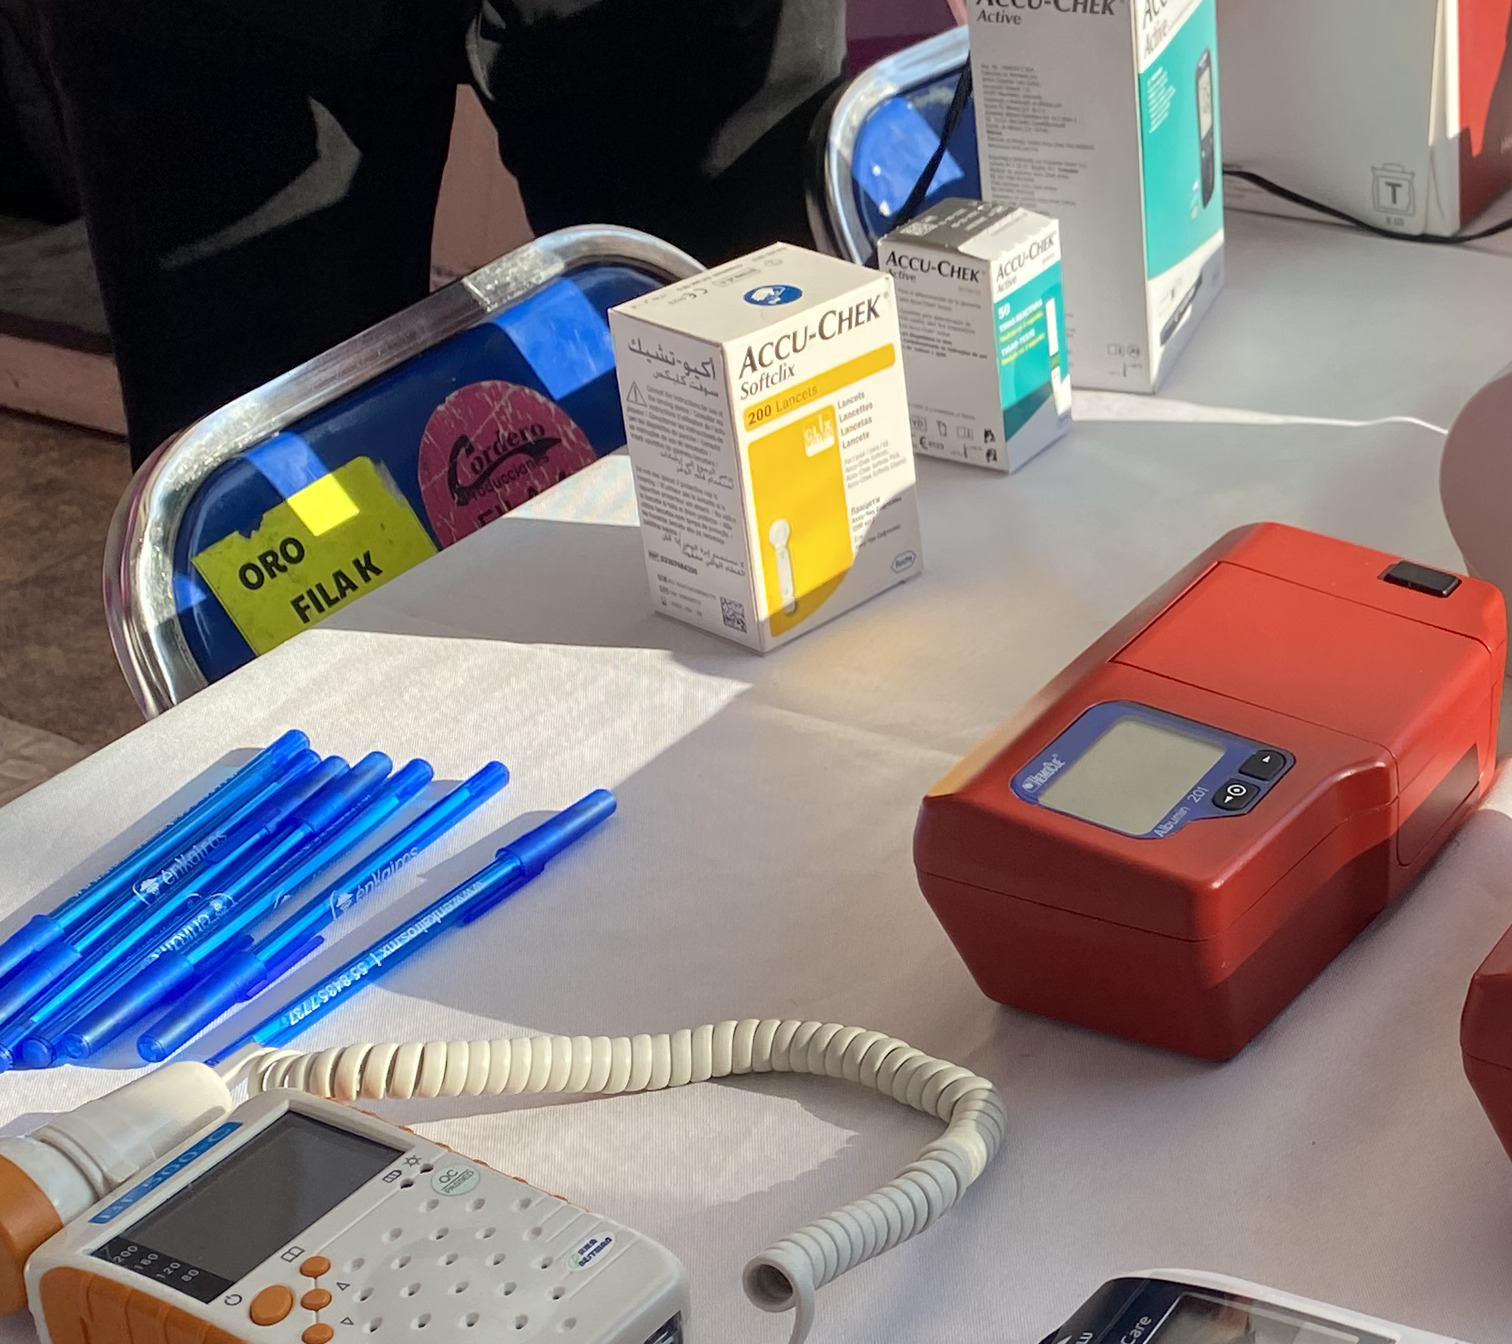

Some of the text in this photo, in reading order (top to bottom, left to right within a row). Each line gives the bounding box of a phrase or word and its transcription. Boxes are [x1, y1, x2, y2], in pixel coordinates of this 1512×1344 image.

[977, 8, 1022, 25] Active
[1385, 181, 1402, 205] T
[885, 250, 981, 284] ACCU-CHEK
[996, 234, 1055, 282] ACCU-CHEK
[738, 292, 882, 380] ACCU-CHEK
[739, 362, 797, 401] Softclix
[747, 383, 819, 426] 200 Lancets
[447, 421, 546, 507] Cordero
[237, 536, 306, 591] ORO
[289, 550, 384, 624] FILA K
[1152, 785, 1210, 839] Albumin 201
[350, 961, 369, 982] 55
[438, 1167, 460, 1186] QC
